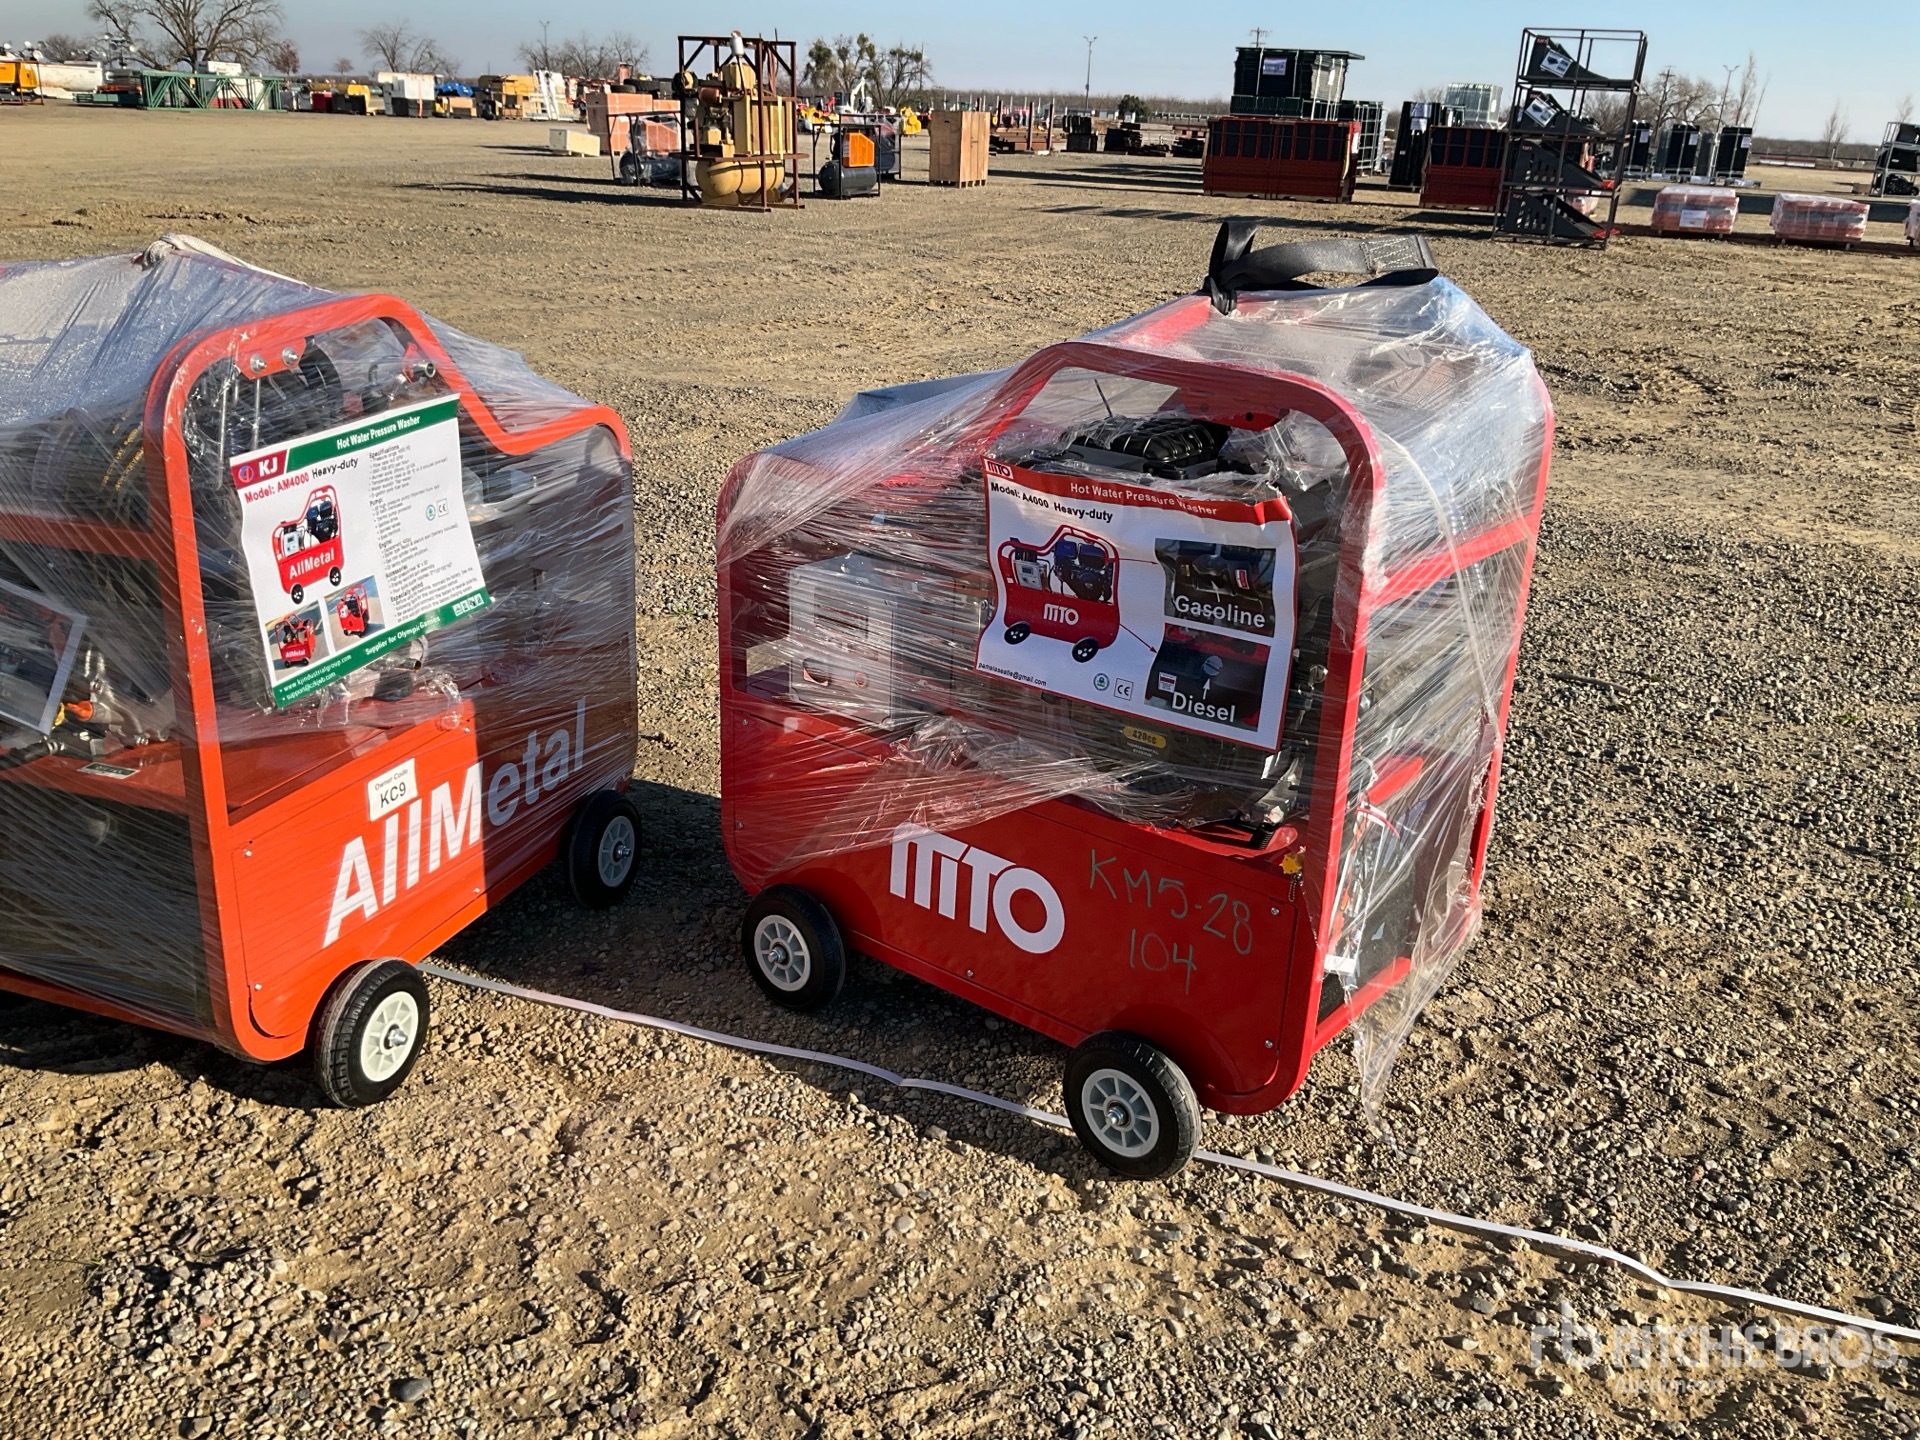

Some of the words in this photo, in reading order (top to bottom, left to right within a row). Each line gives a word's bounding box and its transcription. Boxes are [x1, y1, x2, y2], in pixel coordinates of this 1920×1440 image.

[336, 437, 350, 450] Hot
[350, 432, 370, 446] Water
[370, 423, 397, 439] Pressure
[397, 416, 420, 430] Washer
[244, 485, 275, 504] Model:
[277, 472, 310, 493] AM4000
[312, 458, 359, 479] Heavy-duty
[258, 456, 278, 477] KJ
[991, 482, 1021, 499] Model:
[1022, 492, 1049, 509] A4000
[1054, 502, 1113, 524] Heavy-duty
[1070, 483, 1090, 494] Hot
[1092, 486, 1123, 500] Water
[1125, 490, 1175, 506] Pressure
[289, 548, 335, 580] AllMetal
[1175, 595, 1265, 628] Gasoline
[365, 640, 388, 656] Supplier
[388, 635, 397, 644] for
[1172, 691, 1236, 723] Diesel
[1132, 729, 1157, 745] 420cc
[380, 781, 407, 809] KC9
[322, 697, 586, 949] AllMetal
[1129, 927, 1198, 996] 104
